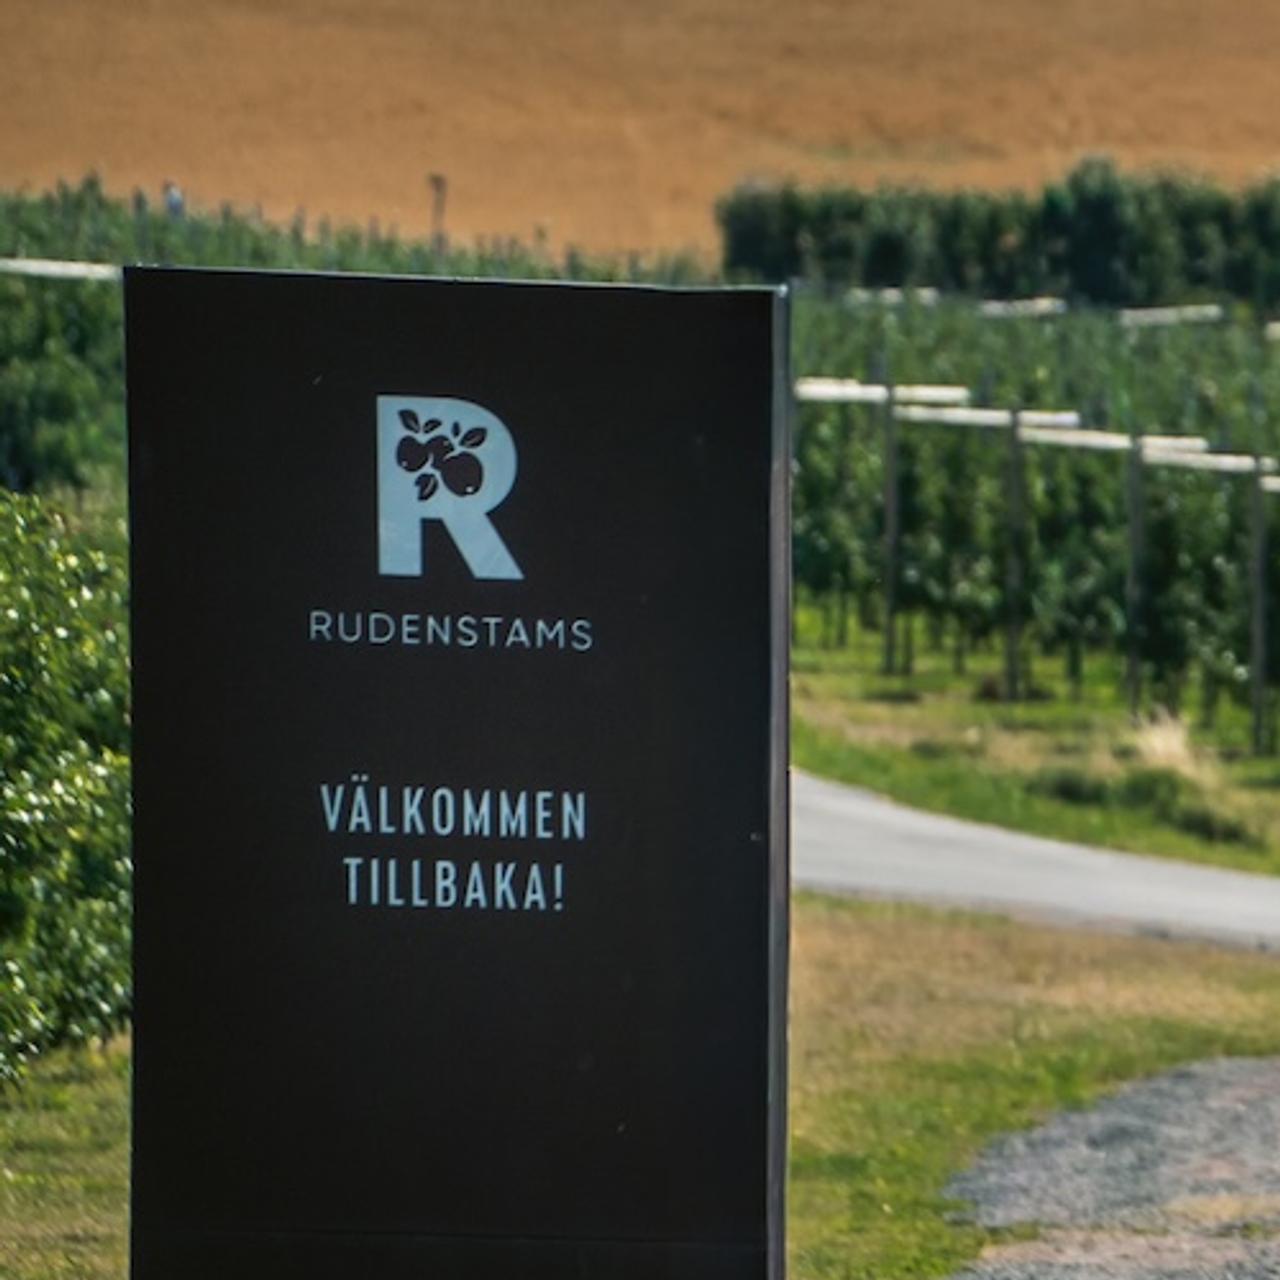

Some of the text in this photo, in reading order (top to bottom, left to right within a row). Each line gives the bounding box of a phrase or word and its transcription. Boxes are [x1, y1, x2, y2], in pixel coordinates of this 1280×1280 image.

[376, 394, 525, 580] R
[309, 610, 593, 651] RUDENSTAMS
[319, 774, 586, 840] VÄLKOMMEN
[342, 857, 564, 911] TILLBAKA!
